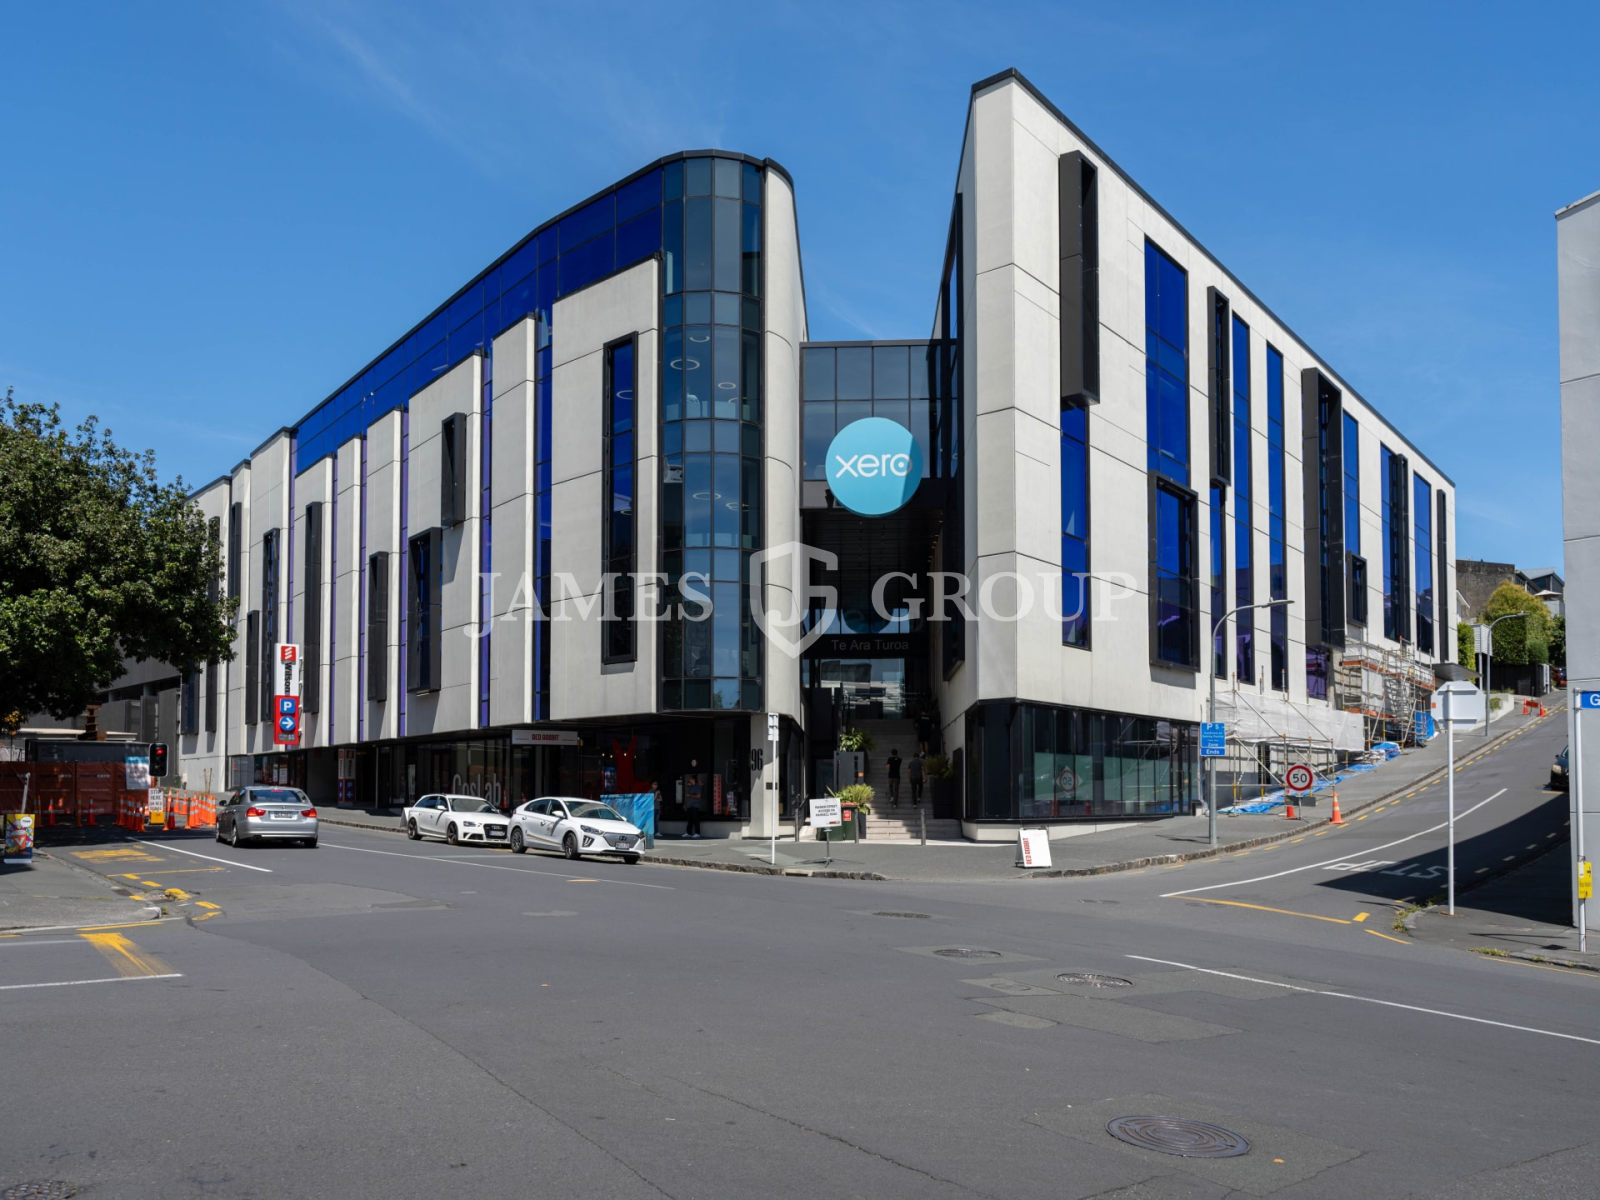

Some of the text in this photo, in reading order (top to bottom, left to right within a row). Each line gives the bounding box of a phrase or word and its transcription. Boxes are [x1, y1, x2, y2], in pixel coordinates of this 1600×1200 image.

[835, 453, 913, 478] xero
[832, 640, 847, 650] Te
[850, 640, 871, 650] Ara
[284, 661, 293, 696] Wilson
[283, 701, 292, 712] P
[751, 748, 764, 771] 96
[1292, 773, 1308, 783] 50
